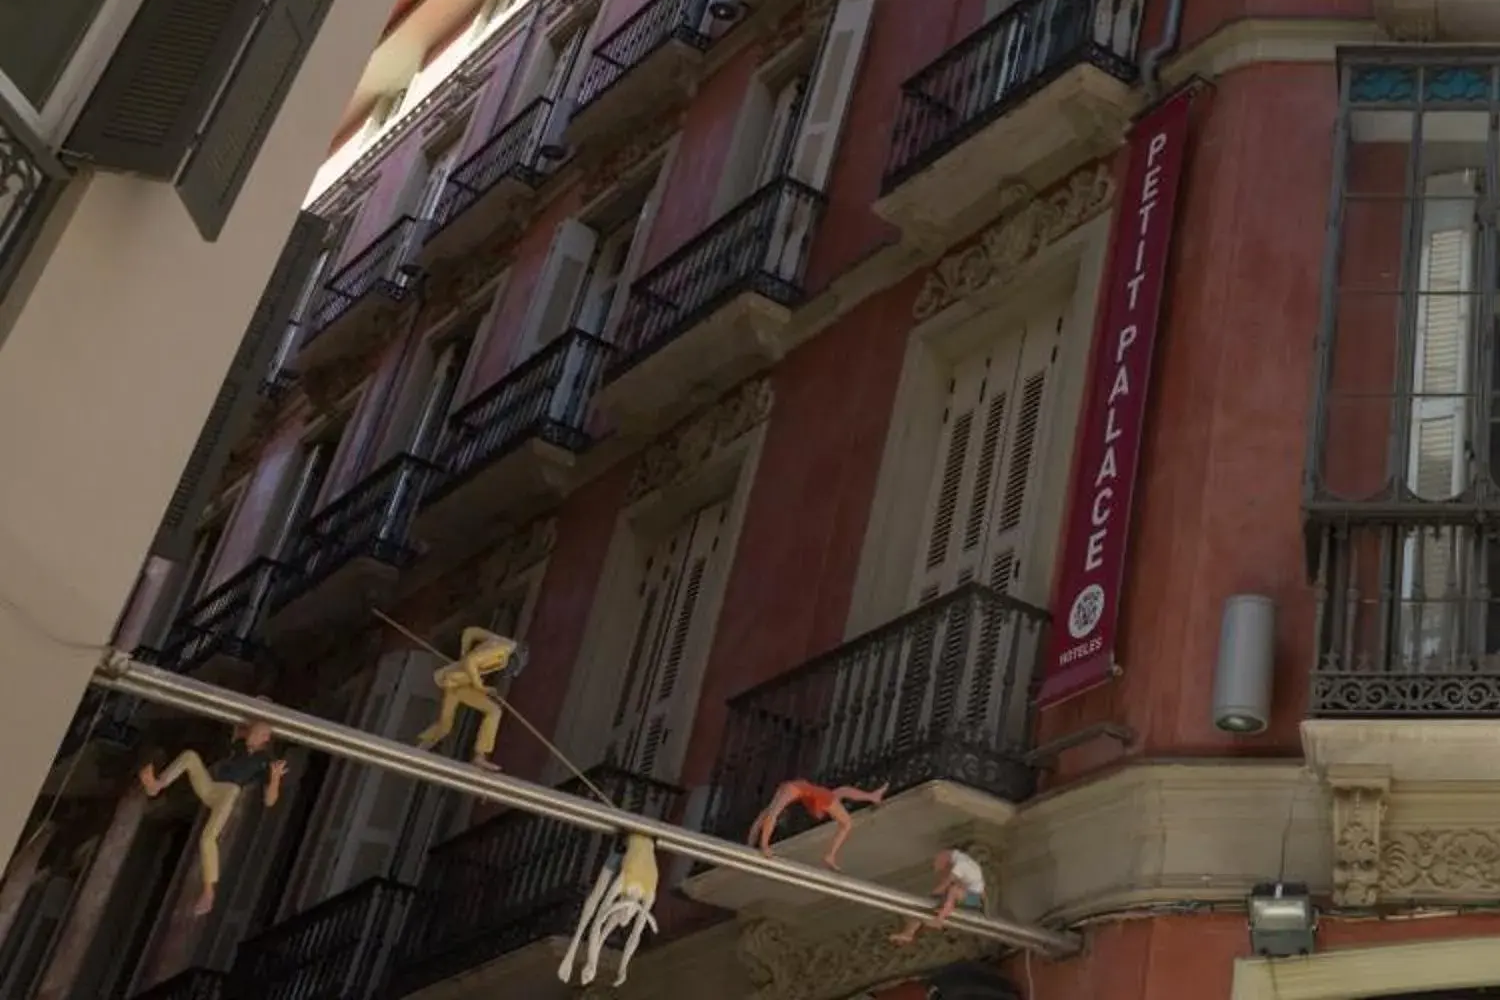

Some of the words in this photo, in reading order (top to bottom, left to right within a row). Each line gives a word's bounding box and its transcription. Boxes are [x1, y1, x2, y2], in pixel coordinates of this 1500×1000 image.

[1127, 132, 1168, 311] PETIT
[1084, 324, 1138, 572] PALACE
[1058, 637, 1103, 666] HOTELES
